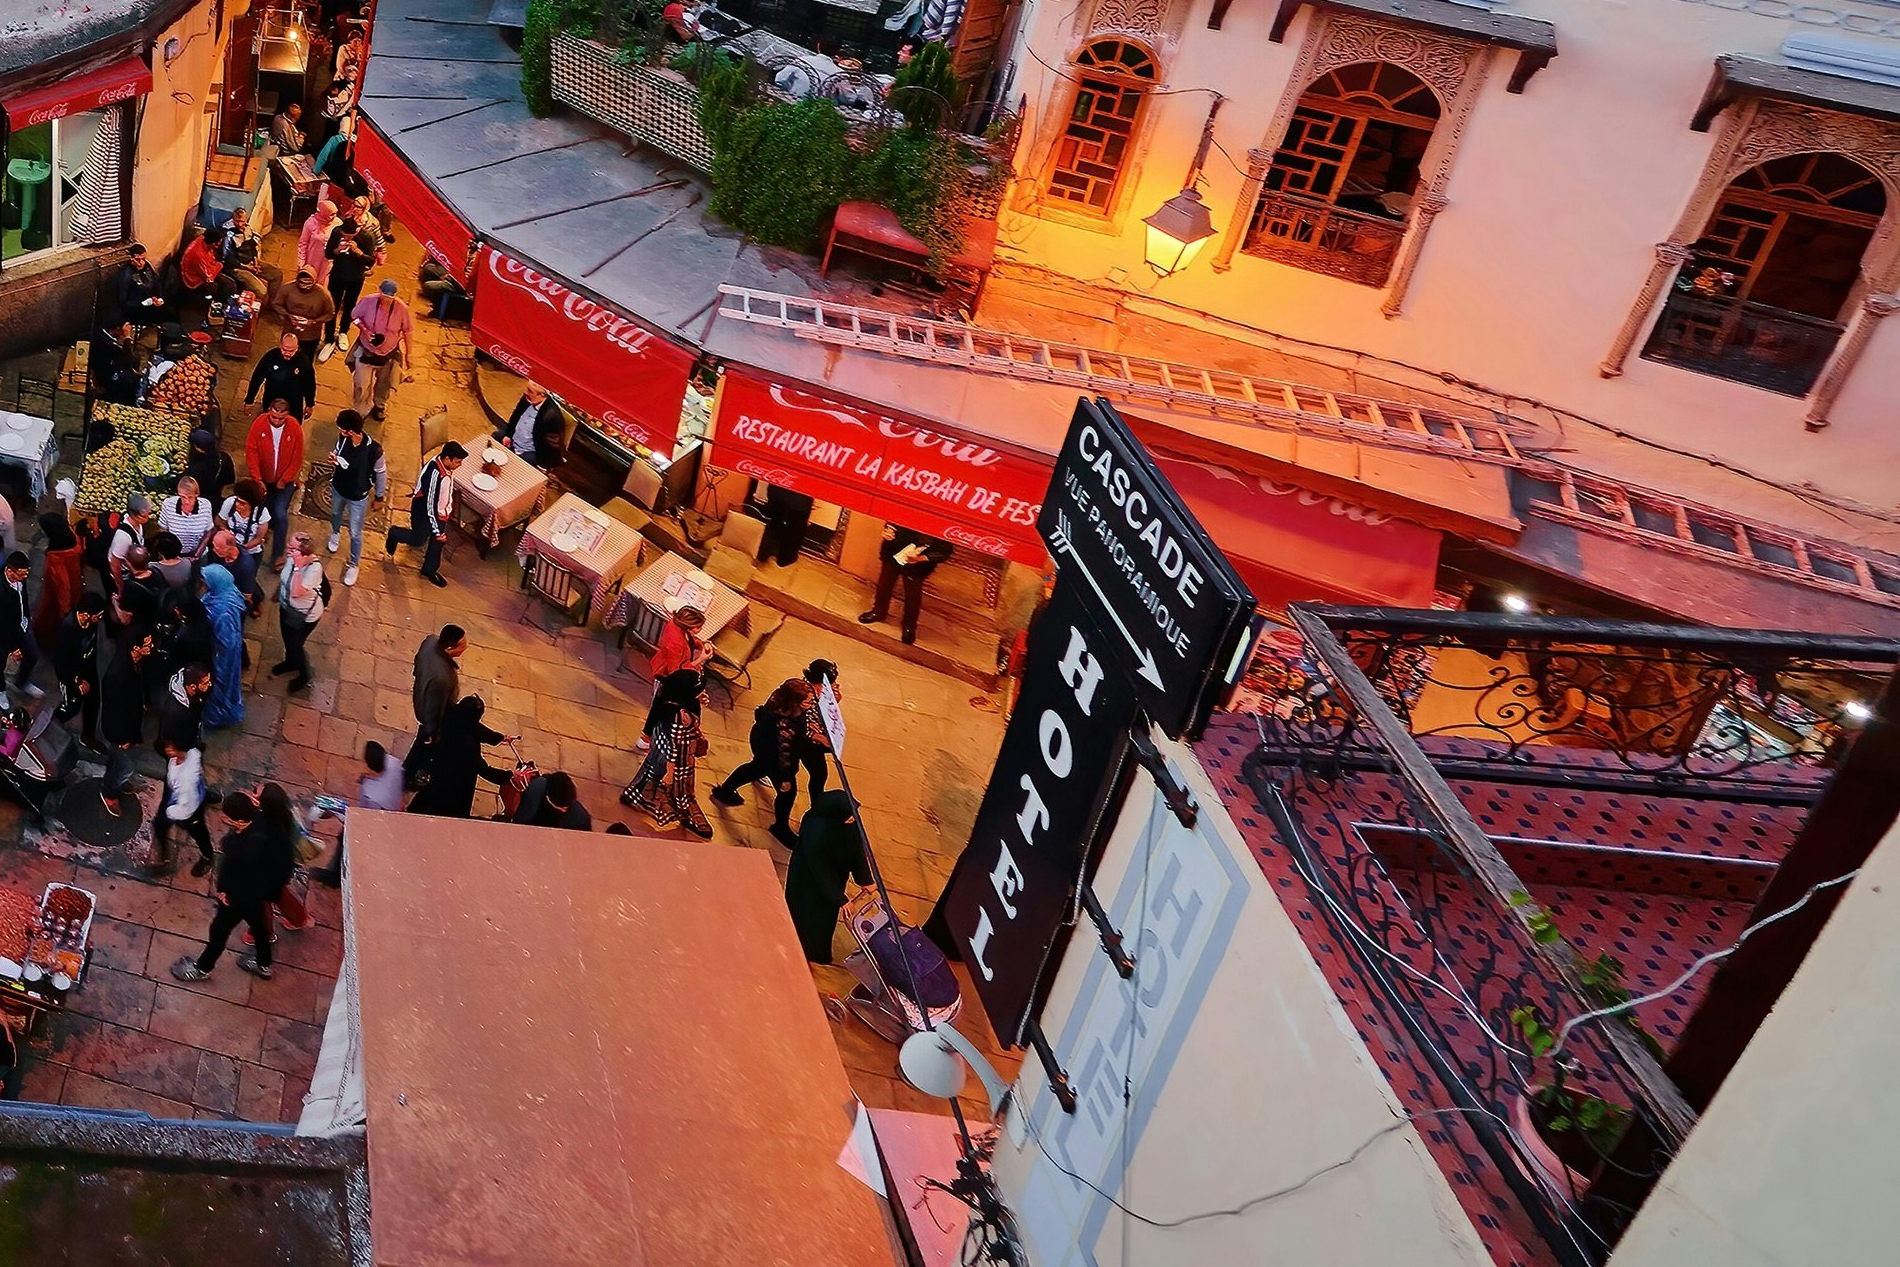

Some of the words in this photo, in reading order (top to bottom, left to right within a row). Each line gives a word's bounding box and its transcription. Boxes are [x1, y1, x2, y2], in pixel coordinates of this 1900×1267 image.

[732, 415, 855, 470] RESTAURANT
[854, 453, 883, 480] LA
[885, 461, 968, 504] KASBAH
[967, 486, 1002, 516] DE
[999, 498, 1043, 527] FES
[1065, 466, 1090, 513] VUE
[1090, 505, 1192, 659] PANORAMIQUE
[1078, 425, 1204, 609] CASCADE
[968, 625, 1105, 982] HOTEL
